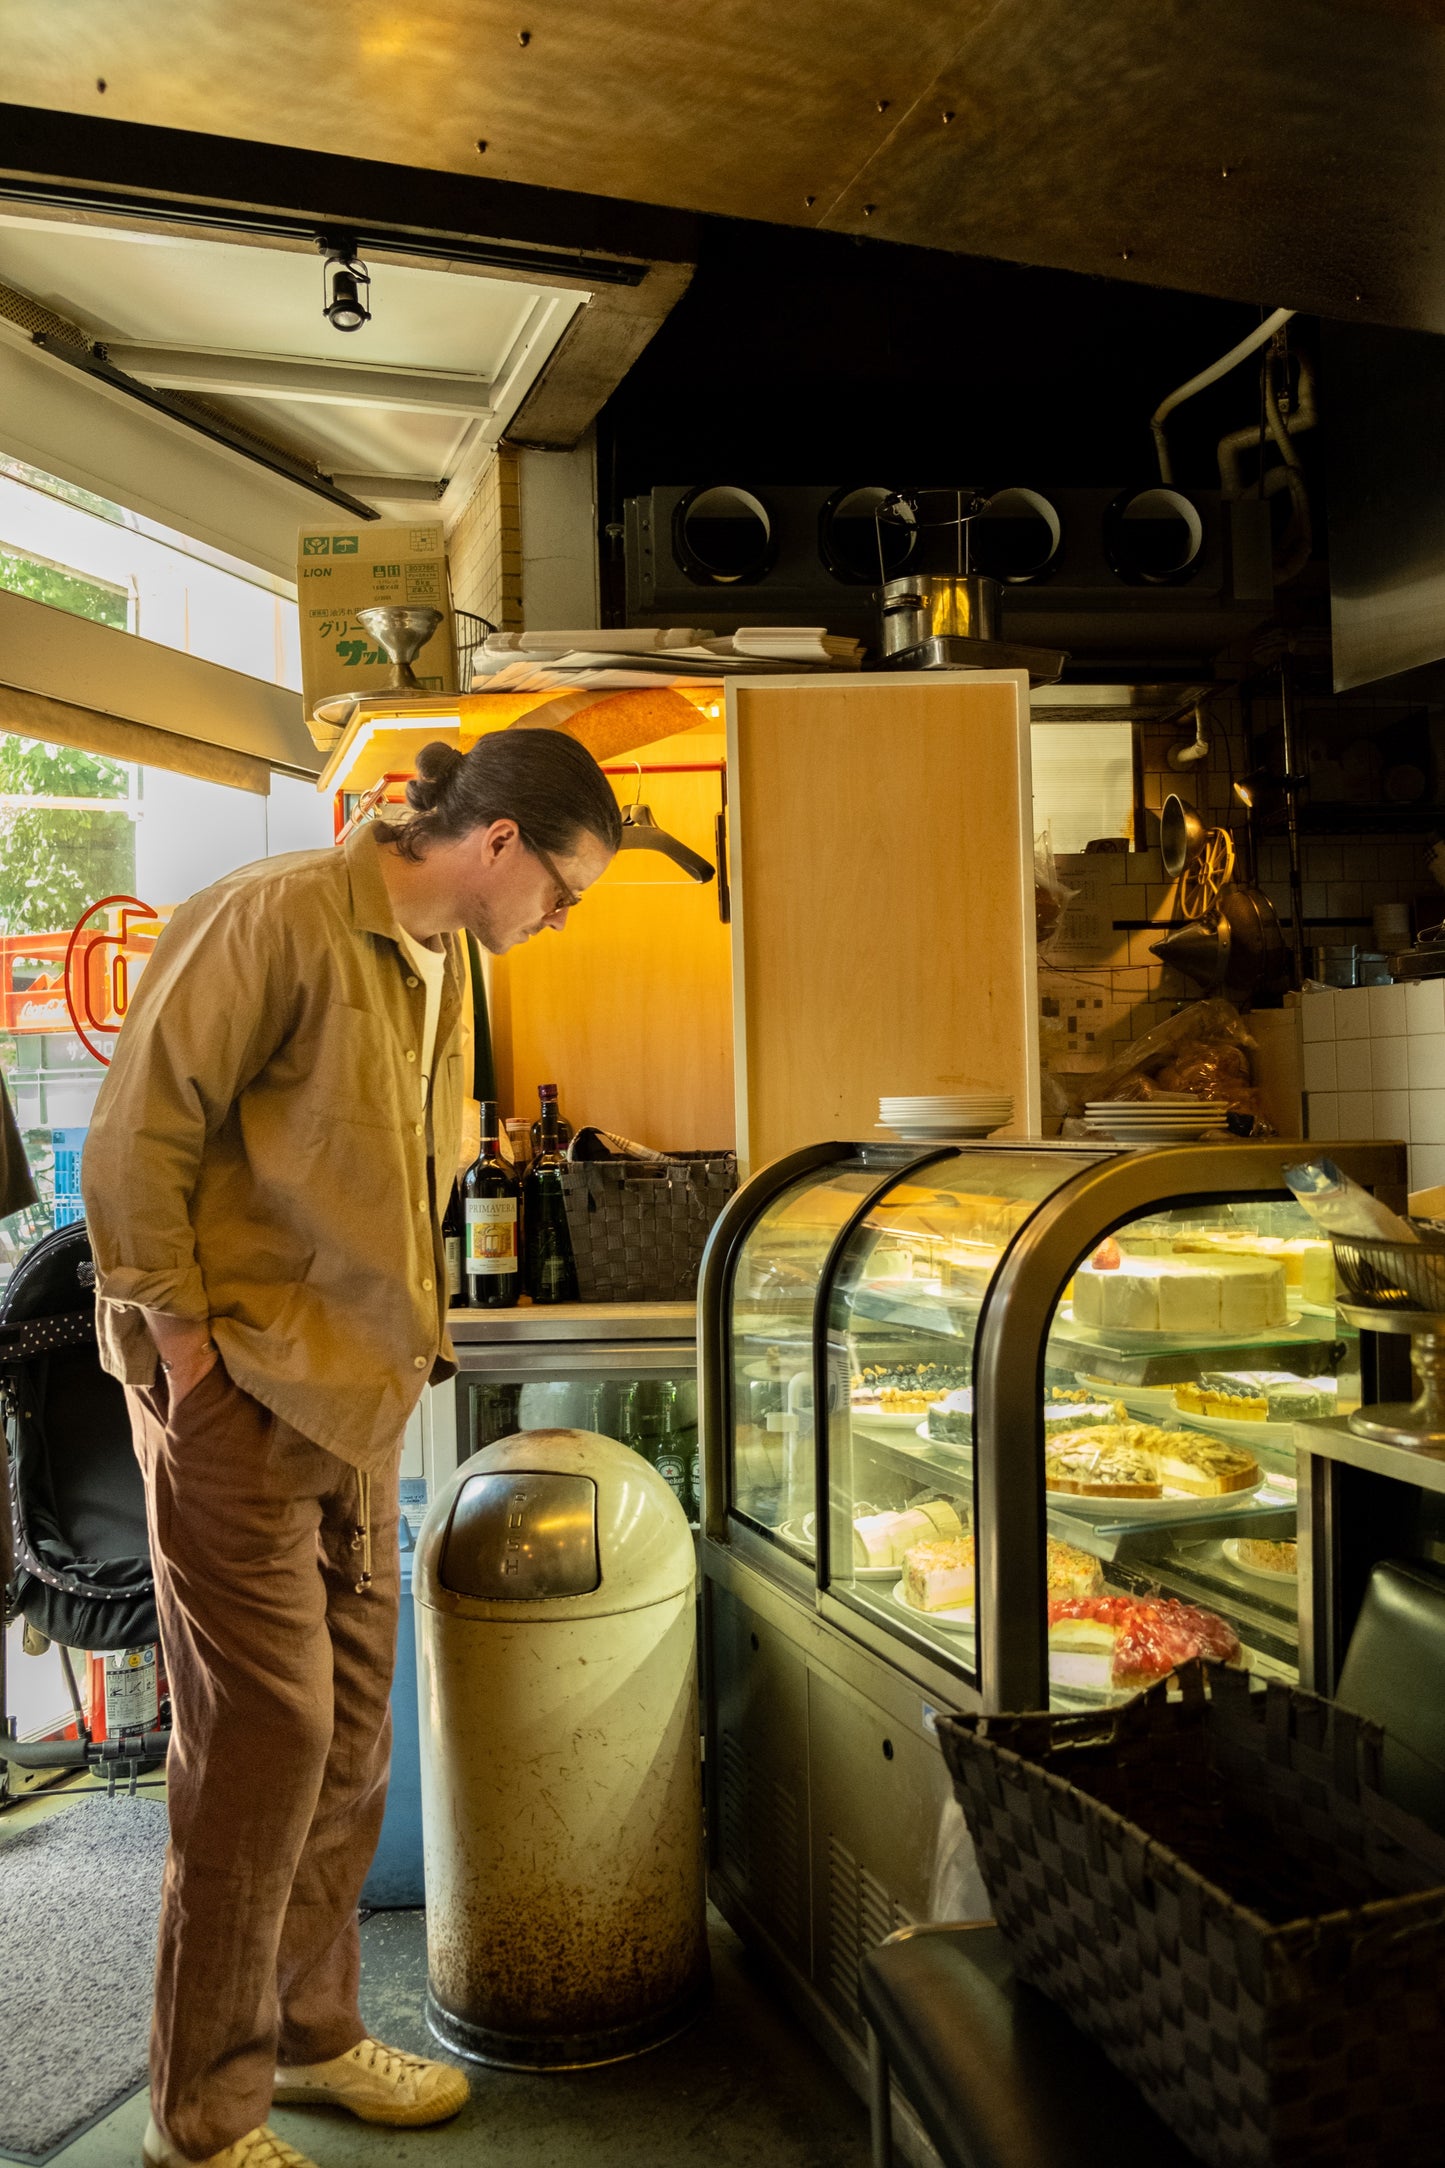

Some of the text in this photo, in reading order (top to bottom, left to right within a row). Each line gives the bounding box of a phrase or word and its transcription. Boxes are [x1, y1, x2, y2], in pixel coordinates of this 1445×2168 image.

[303, 568, 332, 578] LION
[468, 1203, 516, 1214] PRIMAVERA
[505, 1492, 527, 1576] PUSH
